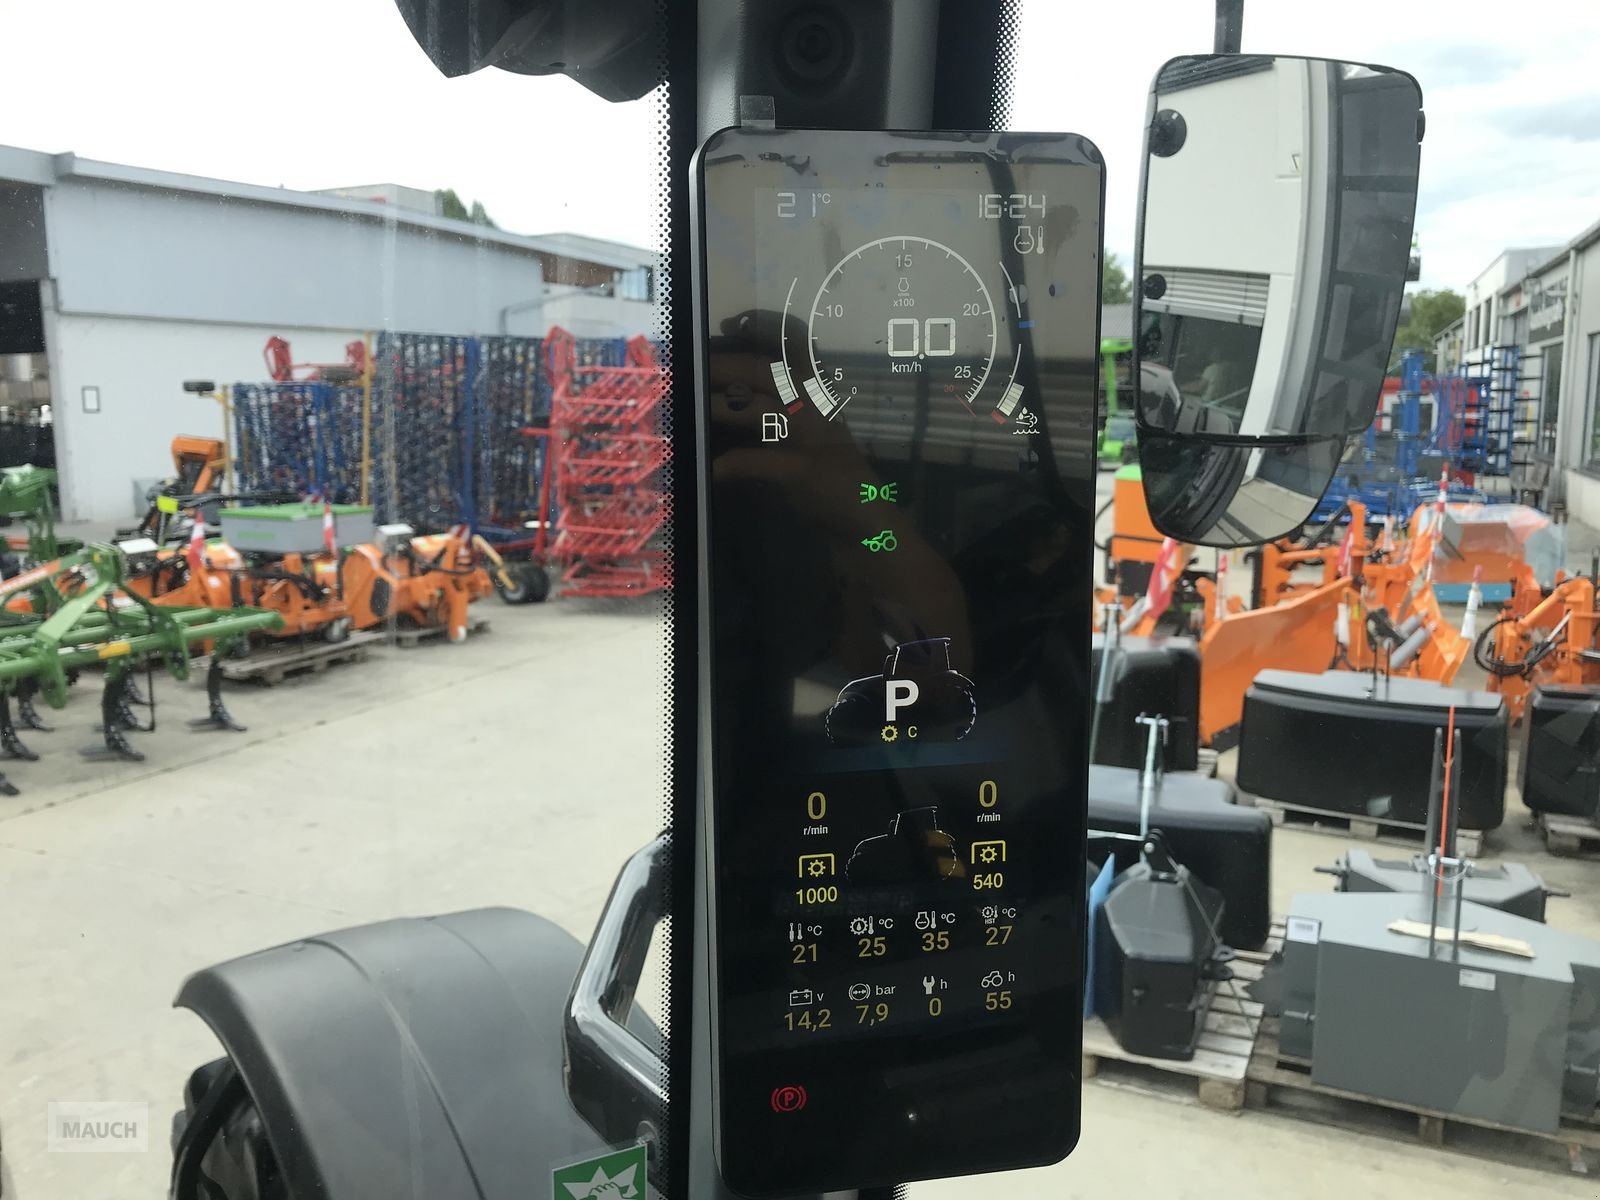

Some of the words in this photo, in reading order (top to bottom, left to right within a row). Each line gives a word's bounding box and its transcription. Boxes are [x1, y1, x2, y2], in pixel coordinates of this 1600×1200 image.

[978, 193, 1046, 219] 16:24
[895, 254, 913, 267] 15
[825, 304, 844, 317] 10
[893, 298, 915, 307] x100
[962, 303, 980, 317] 20
[887, 317, 956, 360] 0.0
[834, 367, 843, 381] 5
[891, 361, 922, 374] km/h
[954, 366, 971, 379] 25
[885, 679, 919, 722] P
[908, 726, 918, 738] C
[978, 780, 998, 808] 0
[807, 792, 827, 820] 0
[976, 811, 1001, 823] r/min
[803, 824, 828, 836] r/min
[972, 872, 1004, 891] 540
[795, 886, 838, 905] 1000
[921, 931, 950, 952] 35
[984, 925, 1013, 946] 27
[792, 943, 818, 964] 21
[858, 936, 887, 958] 25
[940, 979, 948, 990] h
[1008, 971, 1015, 983] h
[875, 984, 896, 997] bar
[928, 997, 942, 1017] 0
[985, 991, 1012, 1011] 55
[783, 1008, 832, 1032] 14,2
[855, 1002, 889, 1026] 7,9
